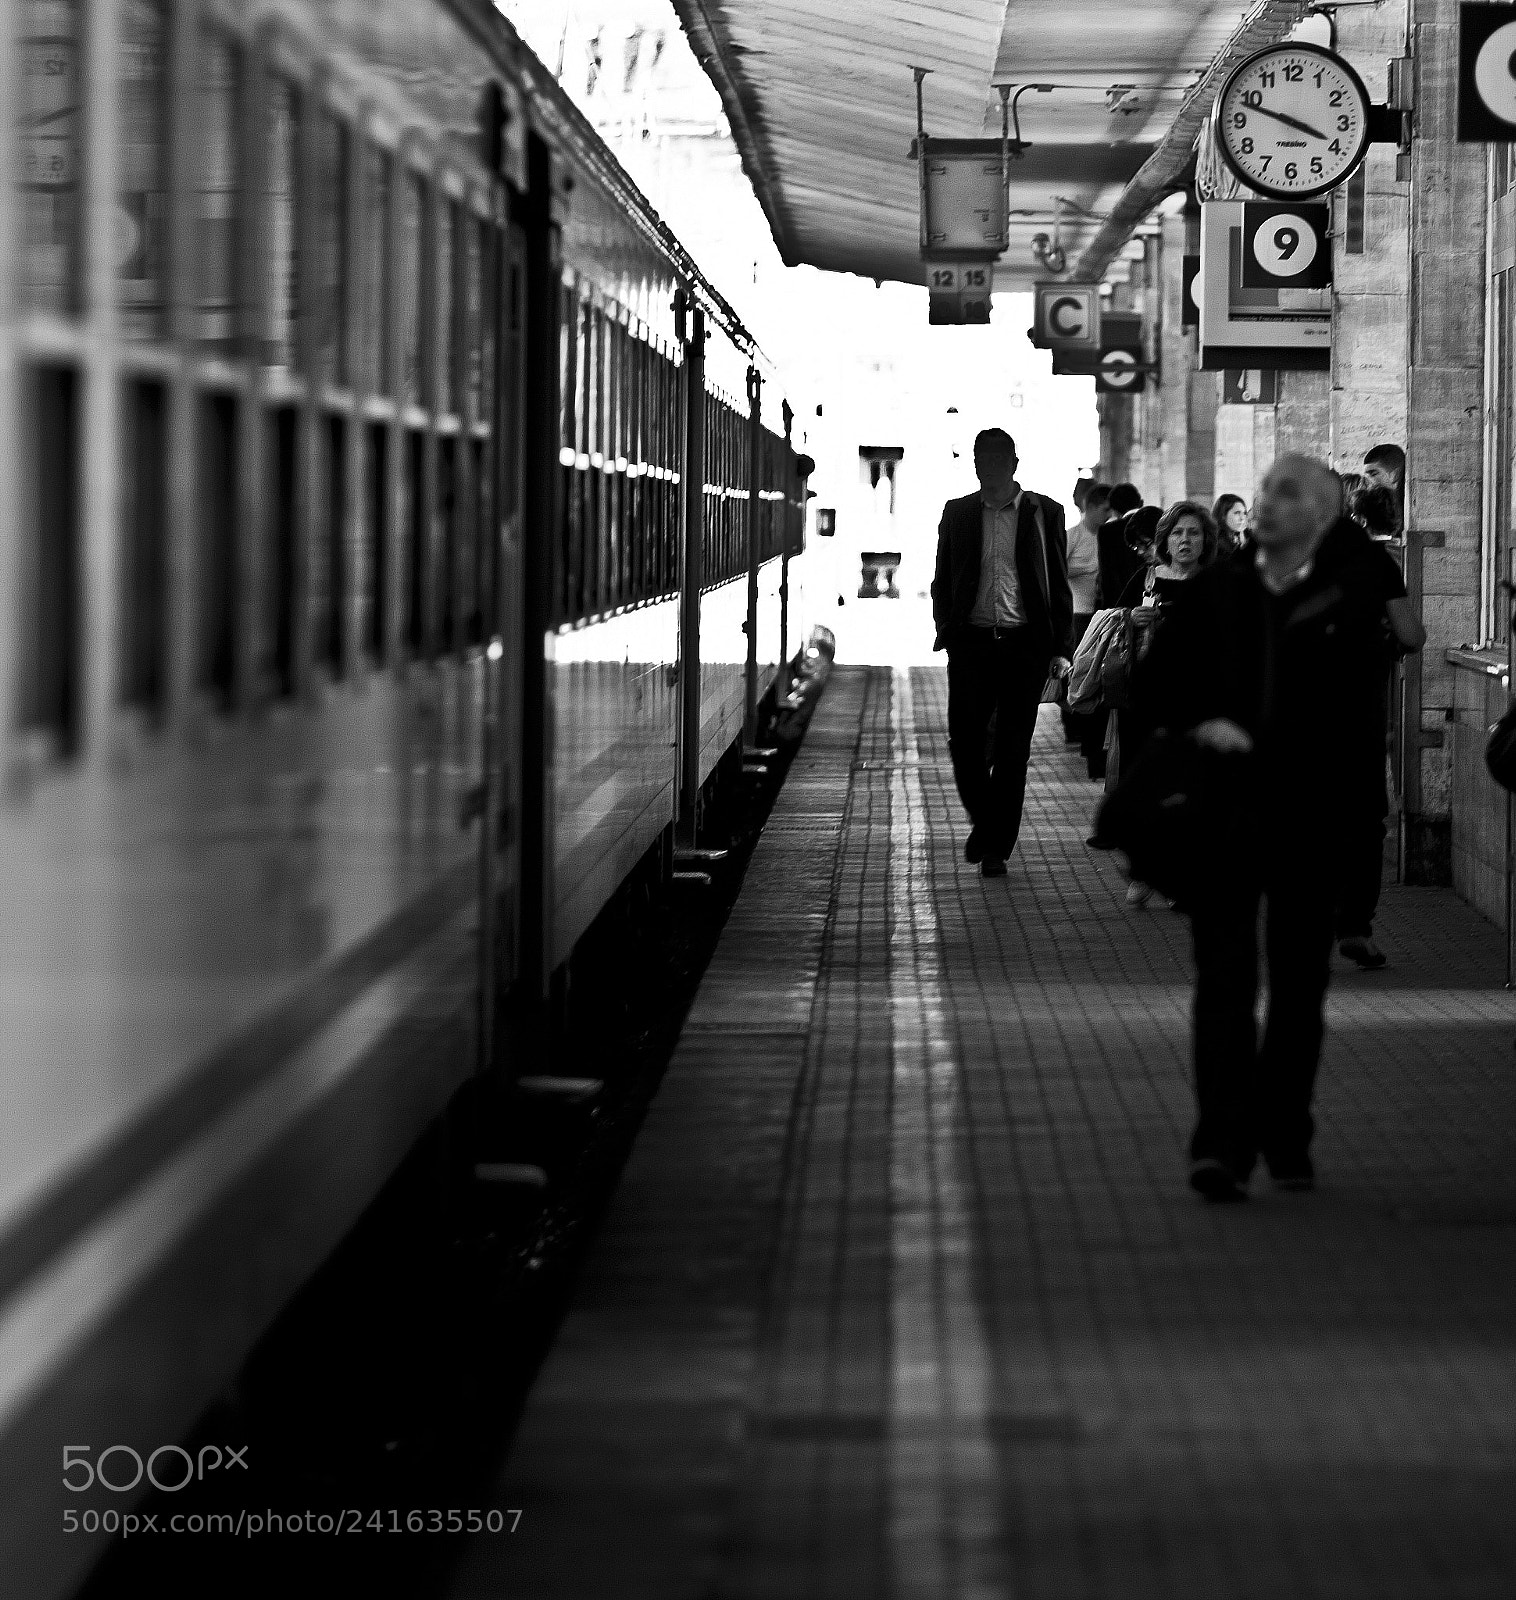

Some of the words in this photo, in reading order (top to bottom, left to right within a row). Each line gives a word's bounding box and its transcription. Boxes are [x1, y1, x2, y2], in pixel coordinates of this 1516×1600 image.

[1258, 71, 1276, 88] 11
[1282, 64, 1303, 82] 12
[1313, 71, 1323, 88] 1
[1240, 90, 1263, 108] 10
[1328, 90, 1343, 107] 2
[1233, 112, 1247, 129] 9
[1336, 115, 1350, 132] 3
[1240, 137, 1255, 154] 8
[1327, 138, 1342, 155] 4
[1259, 155, 1273, 172] 7
[1284, 162, 1298, 180] 6
[1310, 156, 1323, 174] 5
[1273, 227, 1300, 260] 9
[932, 270, 954, 287] 12
[964, 270, 985, 287] 15
[1049, 296, 1083, 337] C
